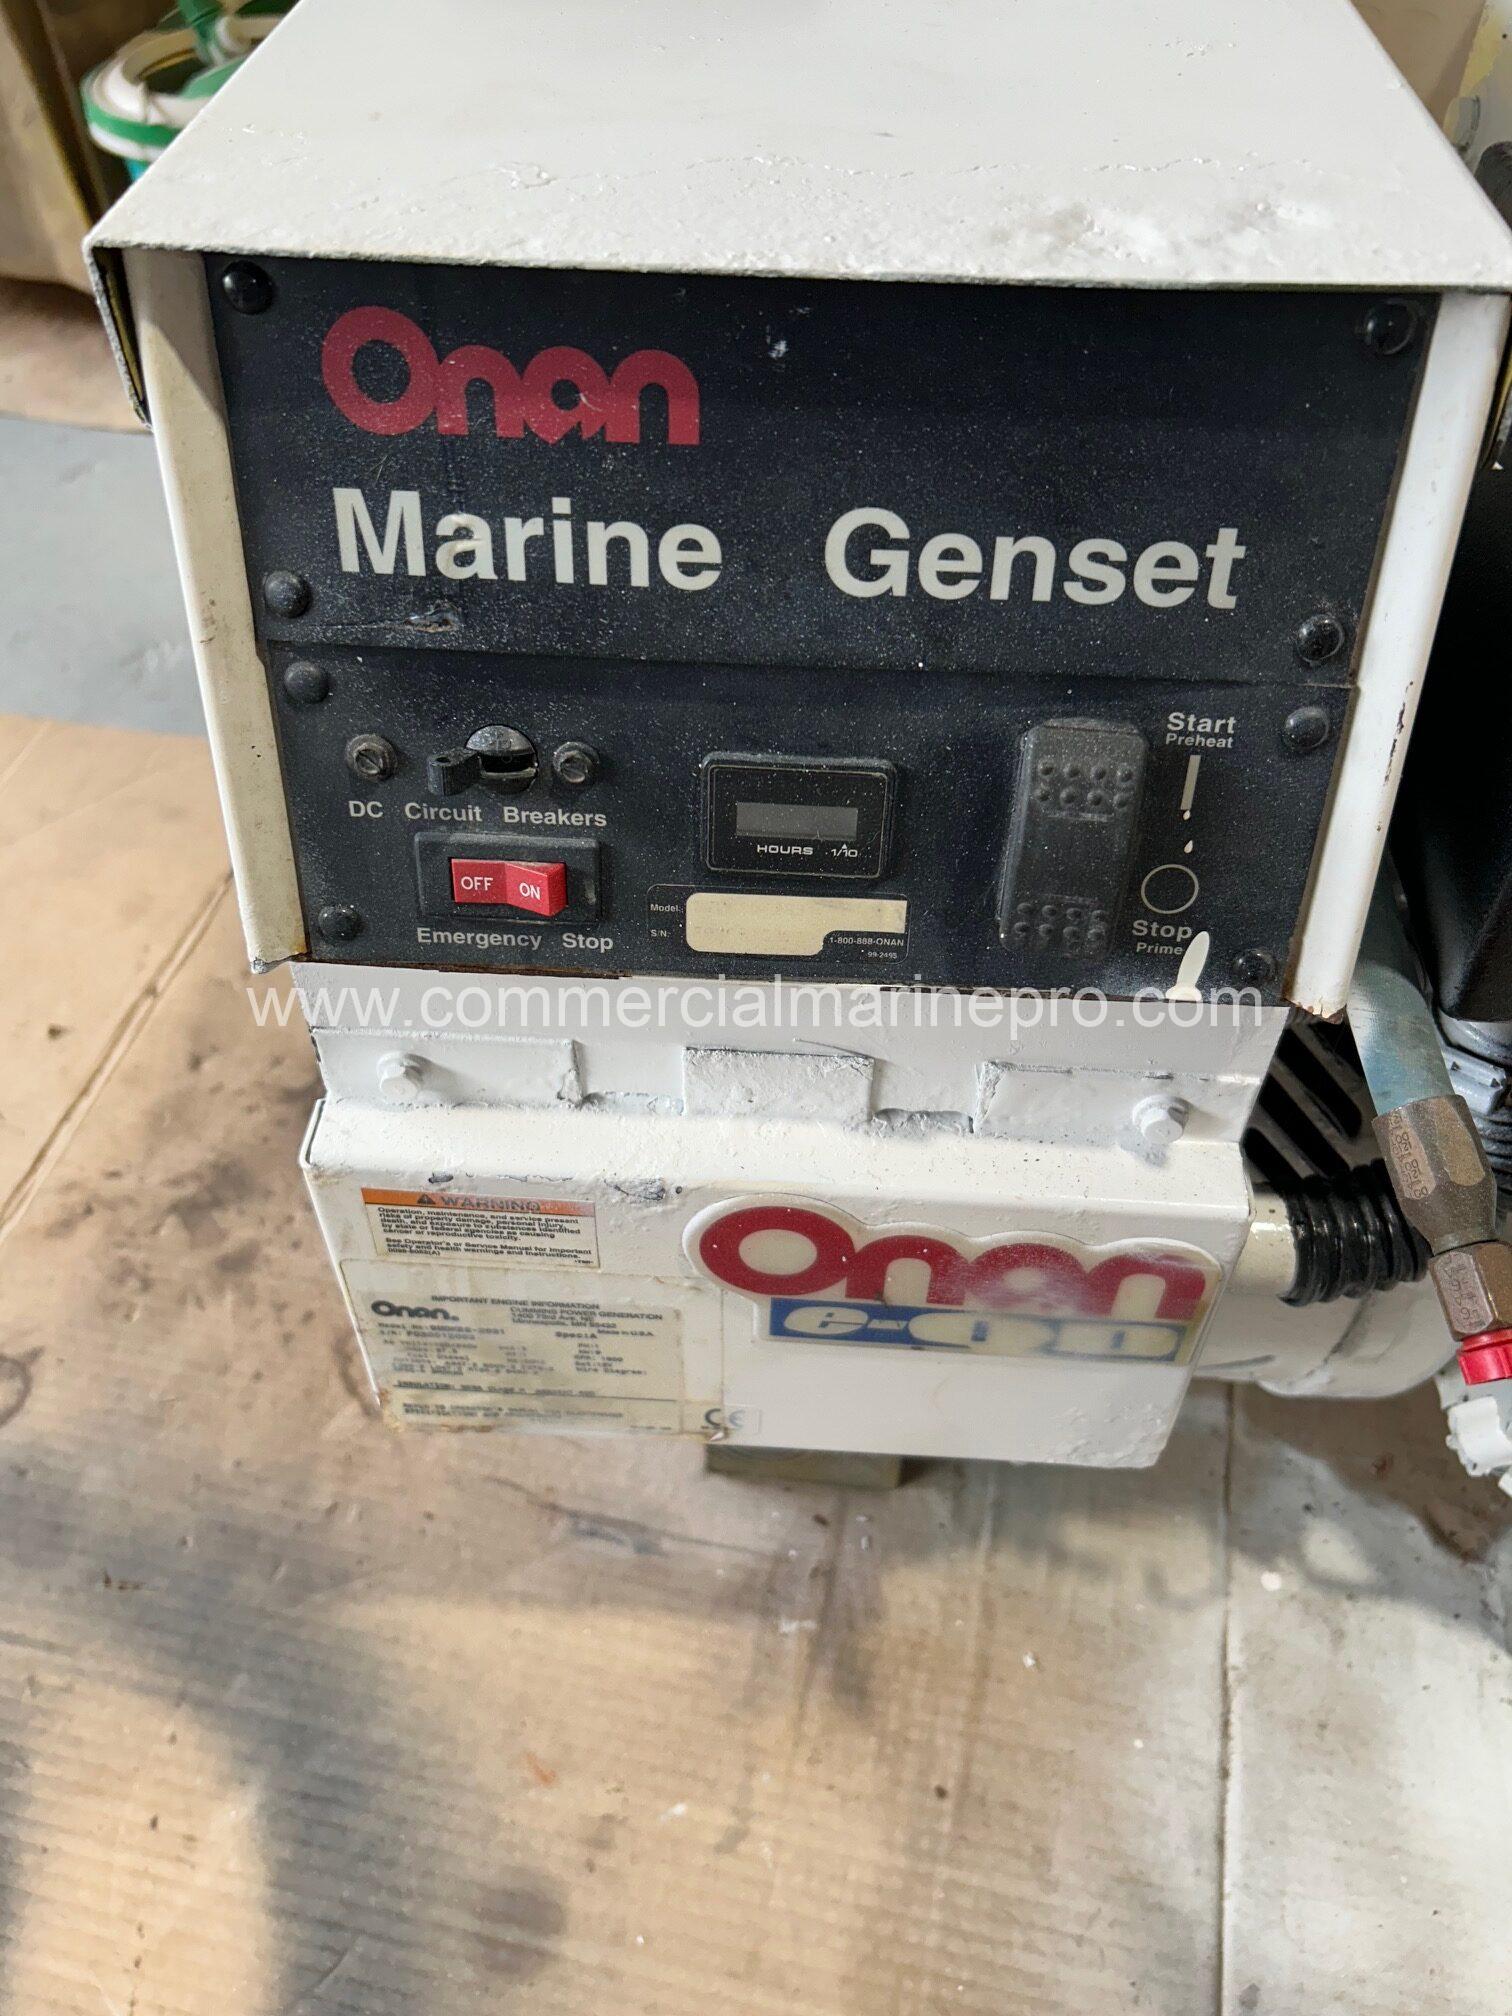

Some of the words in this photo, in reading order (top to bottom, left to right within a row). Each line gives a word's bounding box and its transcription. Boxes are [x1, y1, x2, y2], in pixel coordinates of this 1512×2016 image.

[321, 305, 699, 446] Onan
[332, 487, 723, 591] Marine
[824, 507, 1247, 609] Genset
[1167, 712, 1236, 734] Start
[1165, 733, 1233, 748] Preheat
[350, 801, 384, 818] DC
[404, 802, 482, 822] Circuit
[503, 806, 607, 827] Breakers
[757, 844, 814, 856] HOURS
[461, 876, 494, 891] OFF
[519, 882, 541, 901] ON
[416, 927, 542, 950] Emergency
[562, 932, 614, 953] Stop
[1132, 919, 1193, 942] Stop
[830, 936, 905, 947] 1-800-888-ONAN
[1136, 942, 1184, 955] Prime
[441, 1197, 540, 1211] WARNING
[700, 1206, 1206, 1321] Onan
[371, 1300, 450, 1320] Onan
[431, 1295, 488, 1305] IMPORTANT
[491, 1299, 528, 1307] ENGINE
[531, 1301, 600, 1310] INFORMATION
[560, 1309, 597, 1318] POWER
[598, 1311, 663, 1321] GENERATION
